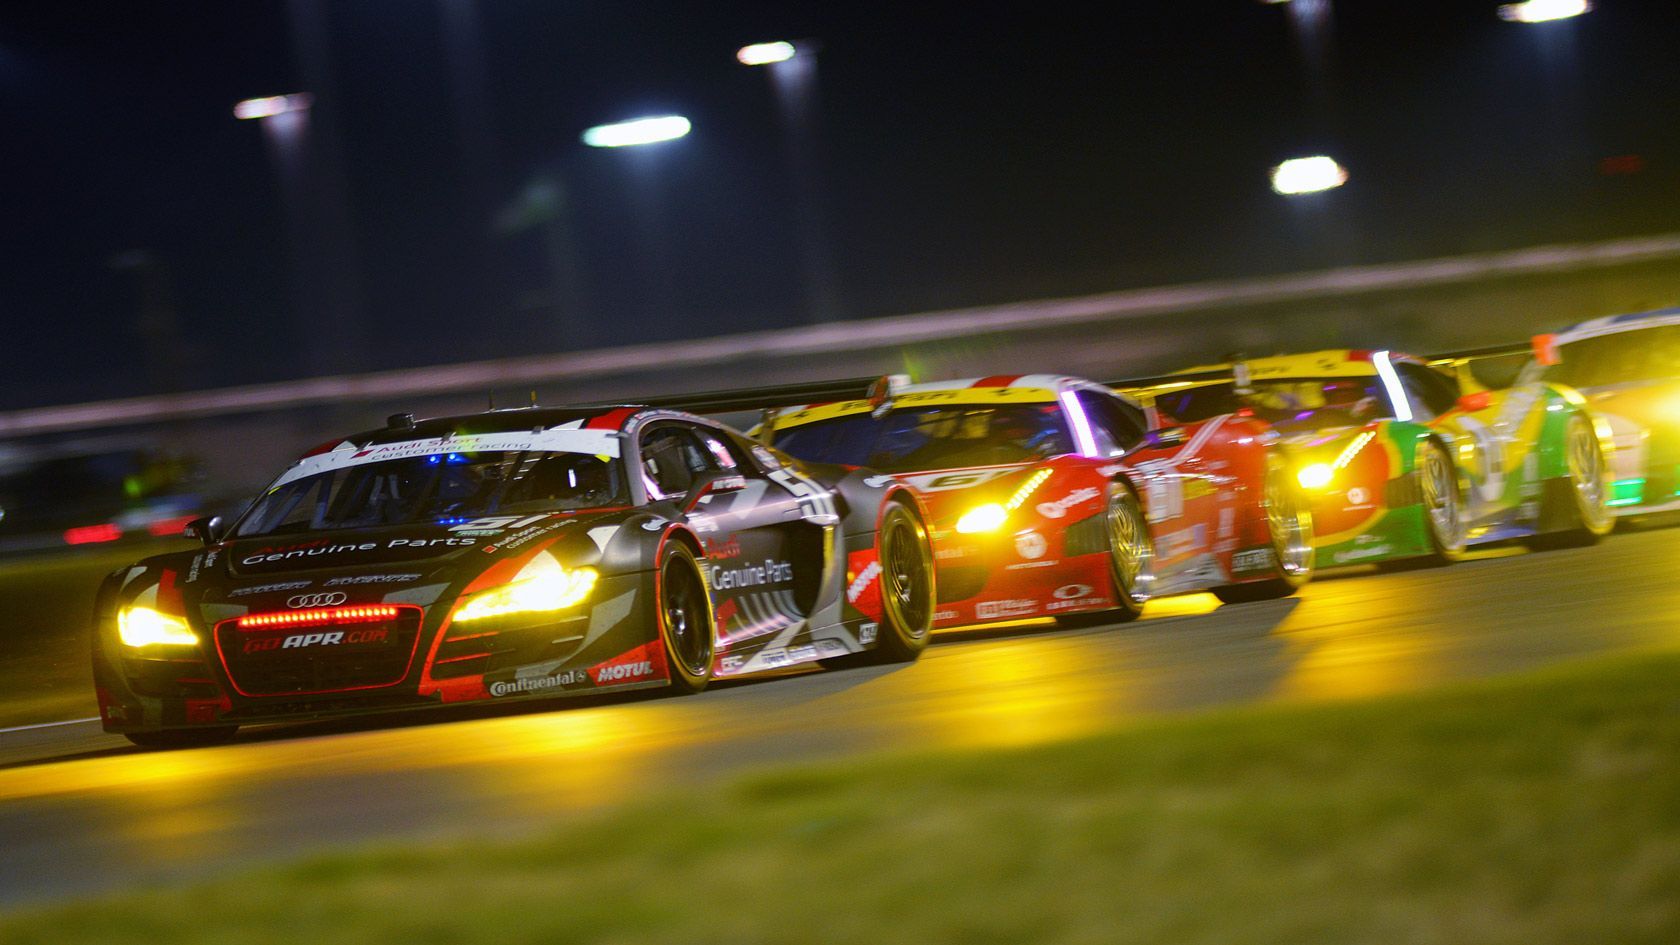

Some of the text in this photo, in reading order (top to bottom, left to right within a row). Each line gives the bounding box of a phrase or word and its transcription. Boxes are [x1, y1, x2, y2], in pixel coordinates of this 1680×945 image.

[371, 441, 532, 460] customer racing
[376, 436, 481, 453] Audi Sport
[242, 537, 477, 565] Genuine Parts
[711, 559, 794, 591] Genuine Parts
[489, 670, 575, 697] Continental
[597, 661, 654, 682] MOTUL
